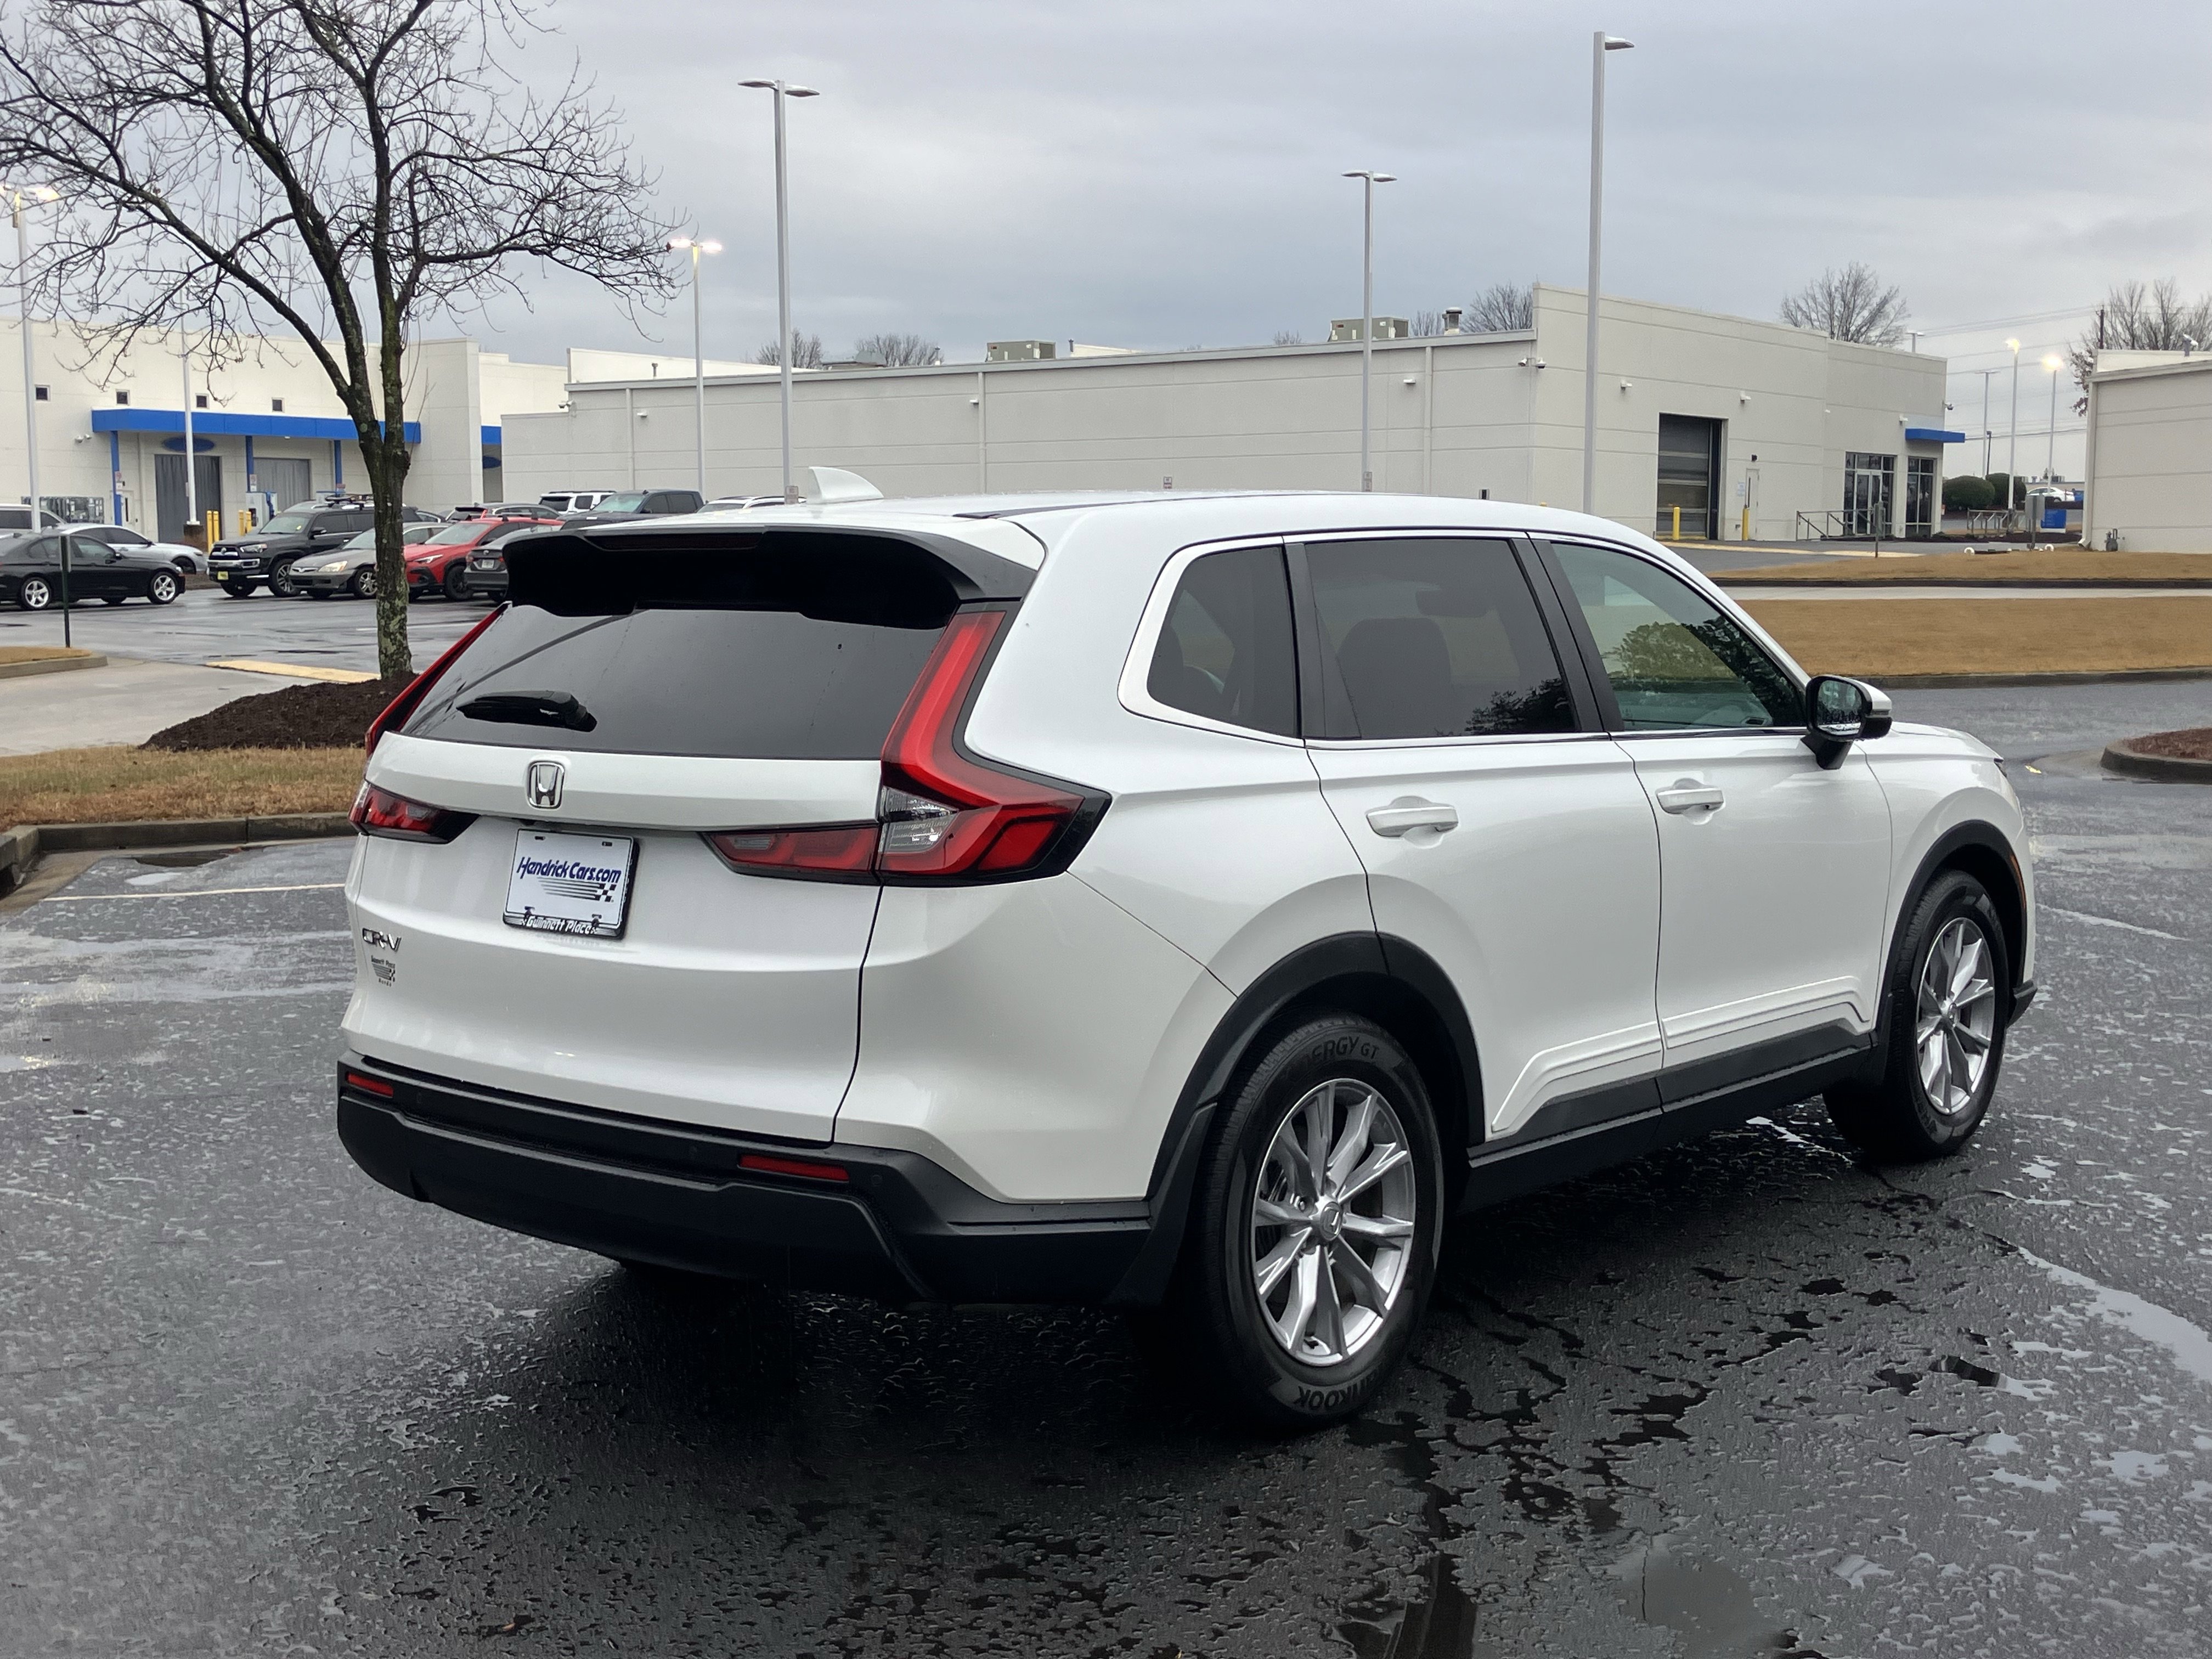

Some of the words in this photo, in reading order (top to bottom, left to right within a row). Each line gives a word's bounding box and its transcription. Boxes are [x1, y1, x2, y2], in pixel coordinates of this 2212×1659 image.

[527, 916, 565, 931] Gwinnett
[565, 919, 591, 934] Place
[362, 927, 402, 952] CR-V
[1361, 1042, 1379, 1060] GT
